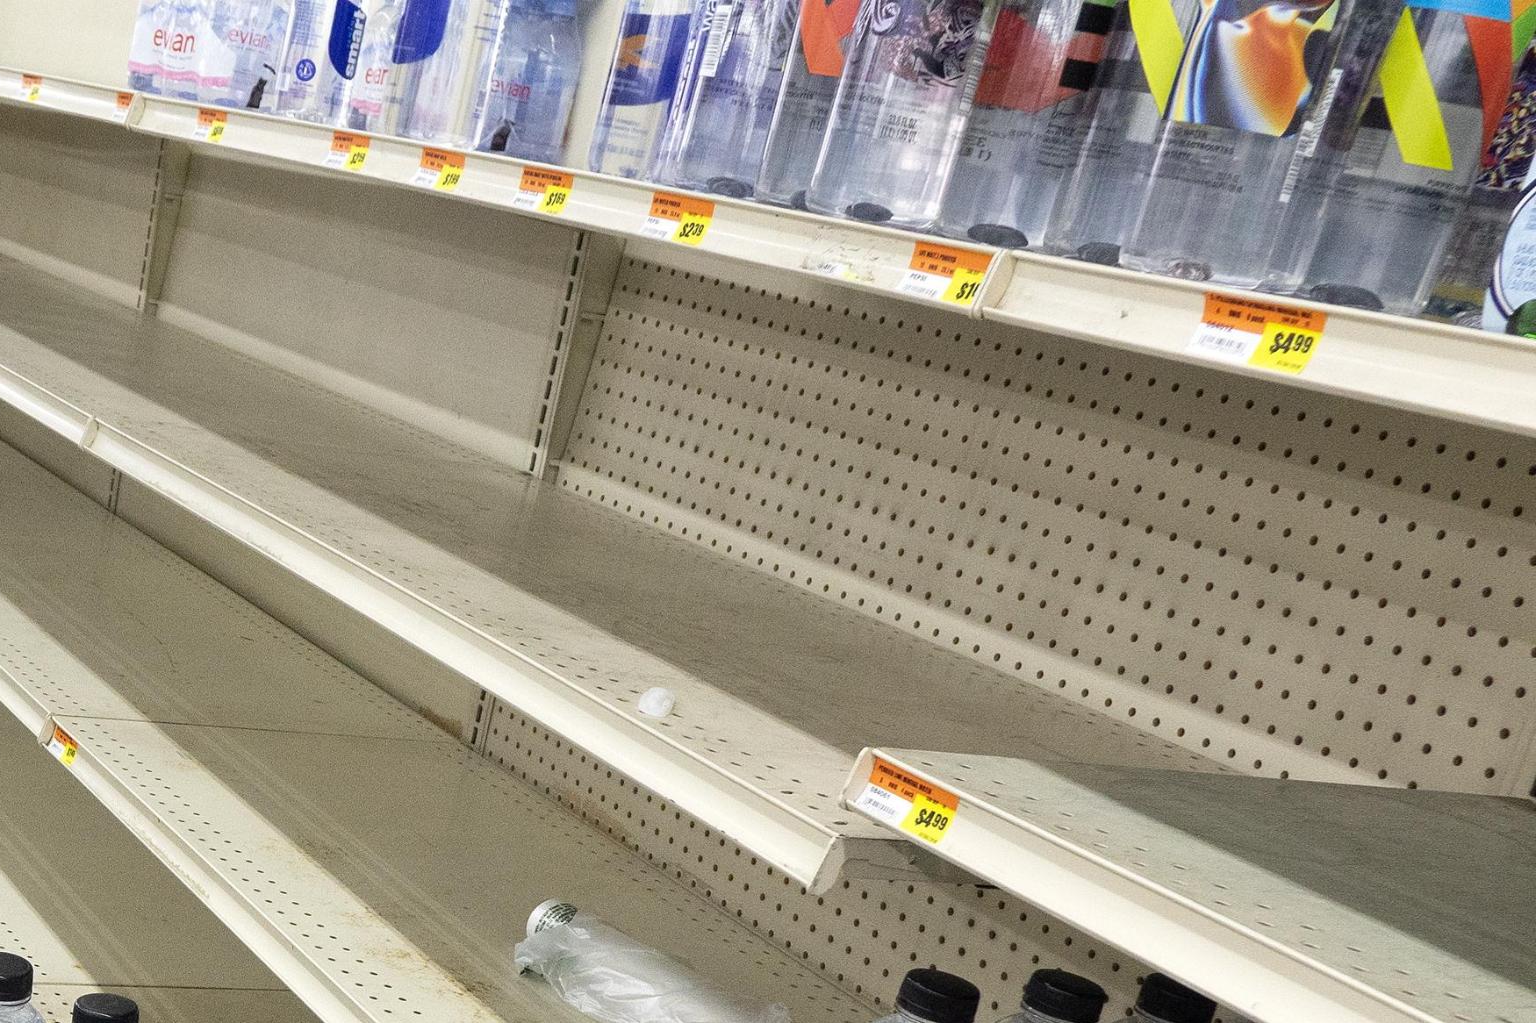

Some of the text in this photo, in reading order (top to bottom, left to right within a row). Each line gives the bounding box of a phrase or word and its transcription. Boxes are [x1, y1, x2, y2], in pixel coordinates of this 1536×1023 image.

[345, 9, 366, 79] smart
[679, 222, 704, 238] $239
[1269, 331, 1314, 354] $499
[915, 808, 949, 831] $499
